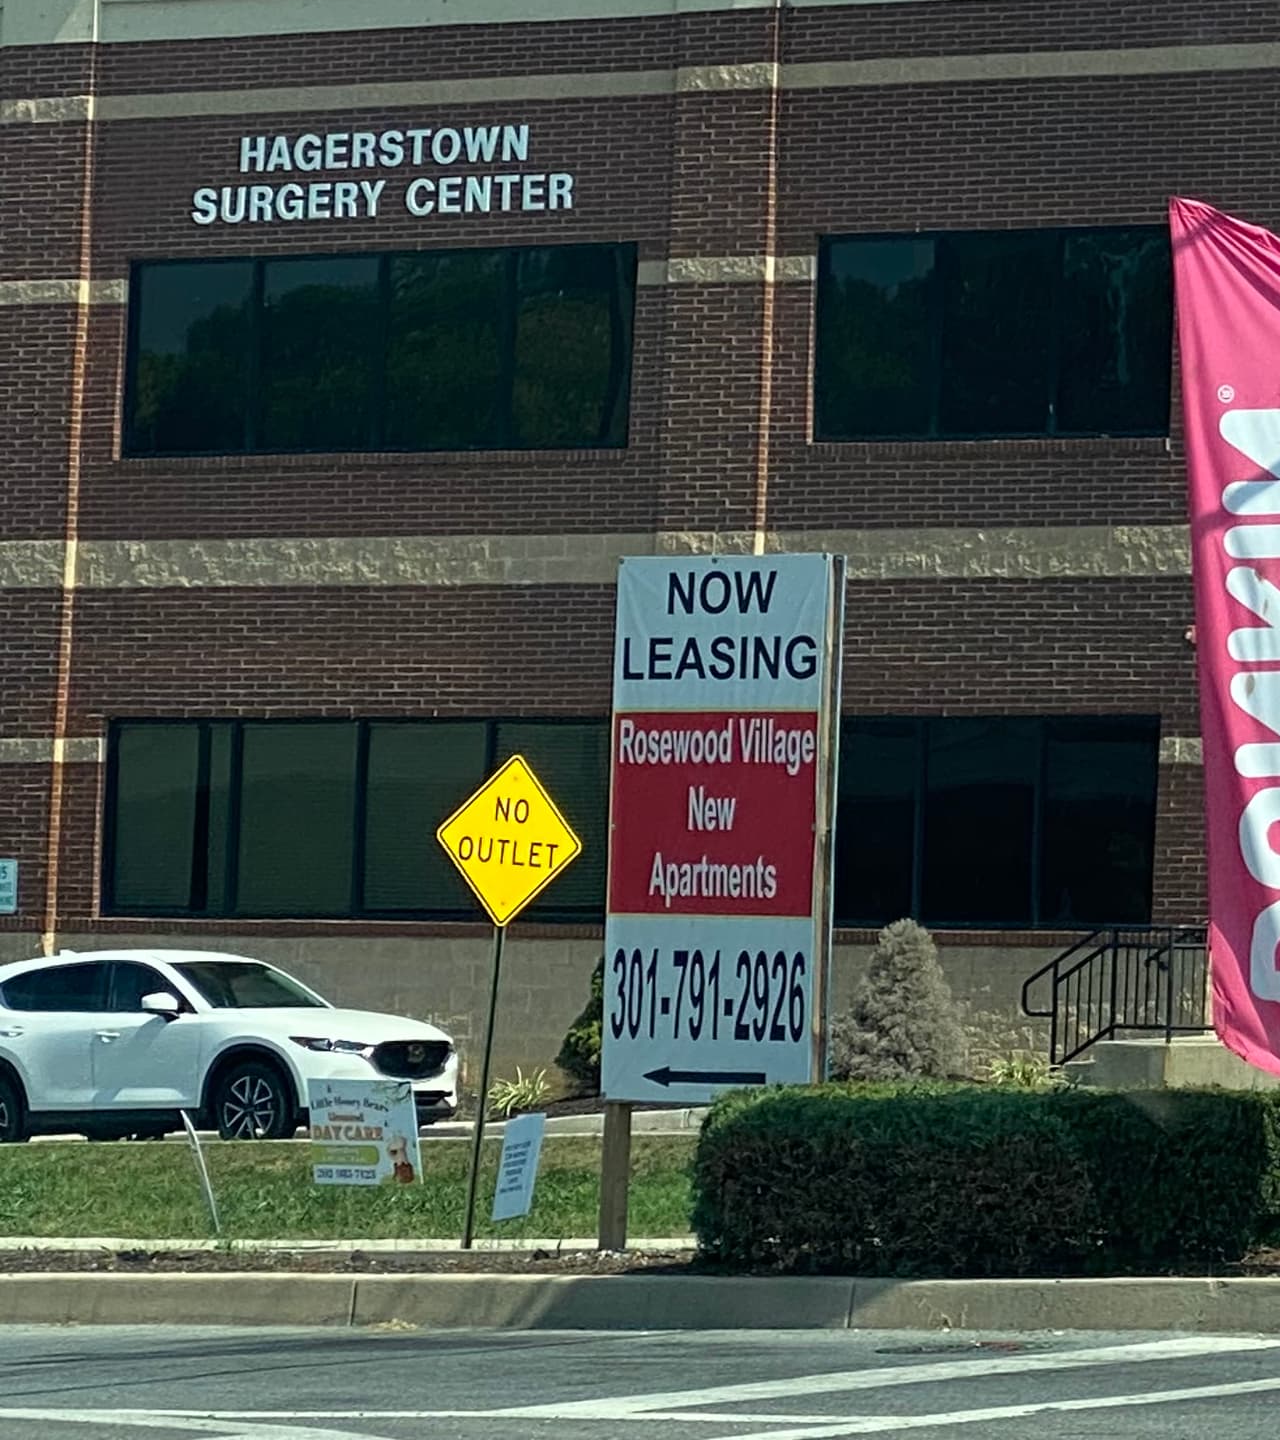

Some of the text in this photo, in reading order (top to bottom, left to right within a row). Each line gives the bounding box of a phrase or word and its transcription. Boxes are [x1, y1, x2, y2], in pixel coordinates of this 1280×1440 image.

[239, 125, 530, 173] HAGERSTOWN
[192, 173, 574, 225] SURGERY CENTER
[667, 570, 777, 615] NOW
[623, 635, 818, 681] LEASING
[619, 717, 815, 776] Rosewood Village
[495, 796, 530, 824] NO
[688, 787, 736, 831] New
[458, 836, 559, 869] OUTLET
[648, 852, 777, 907] Apartments
[611, 948, 806, 1042] 301-791-2926
